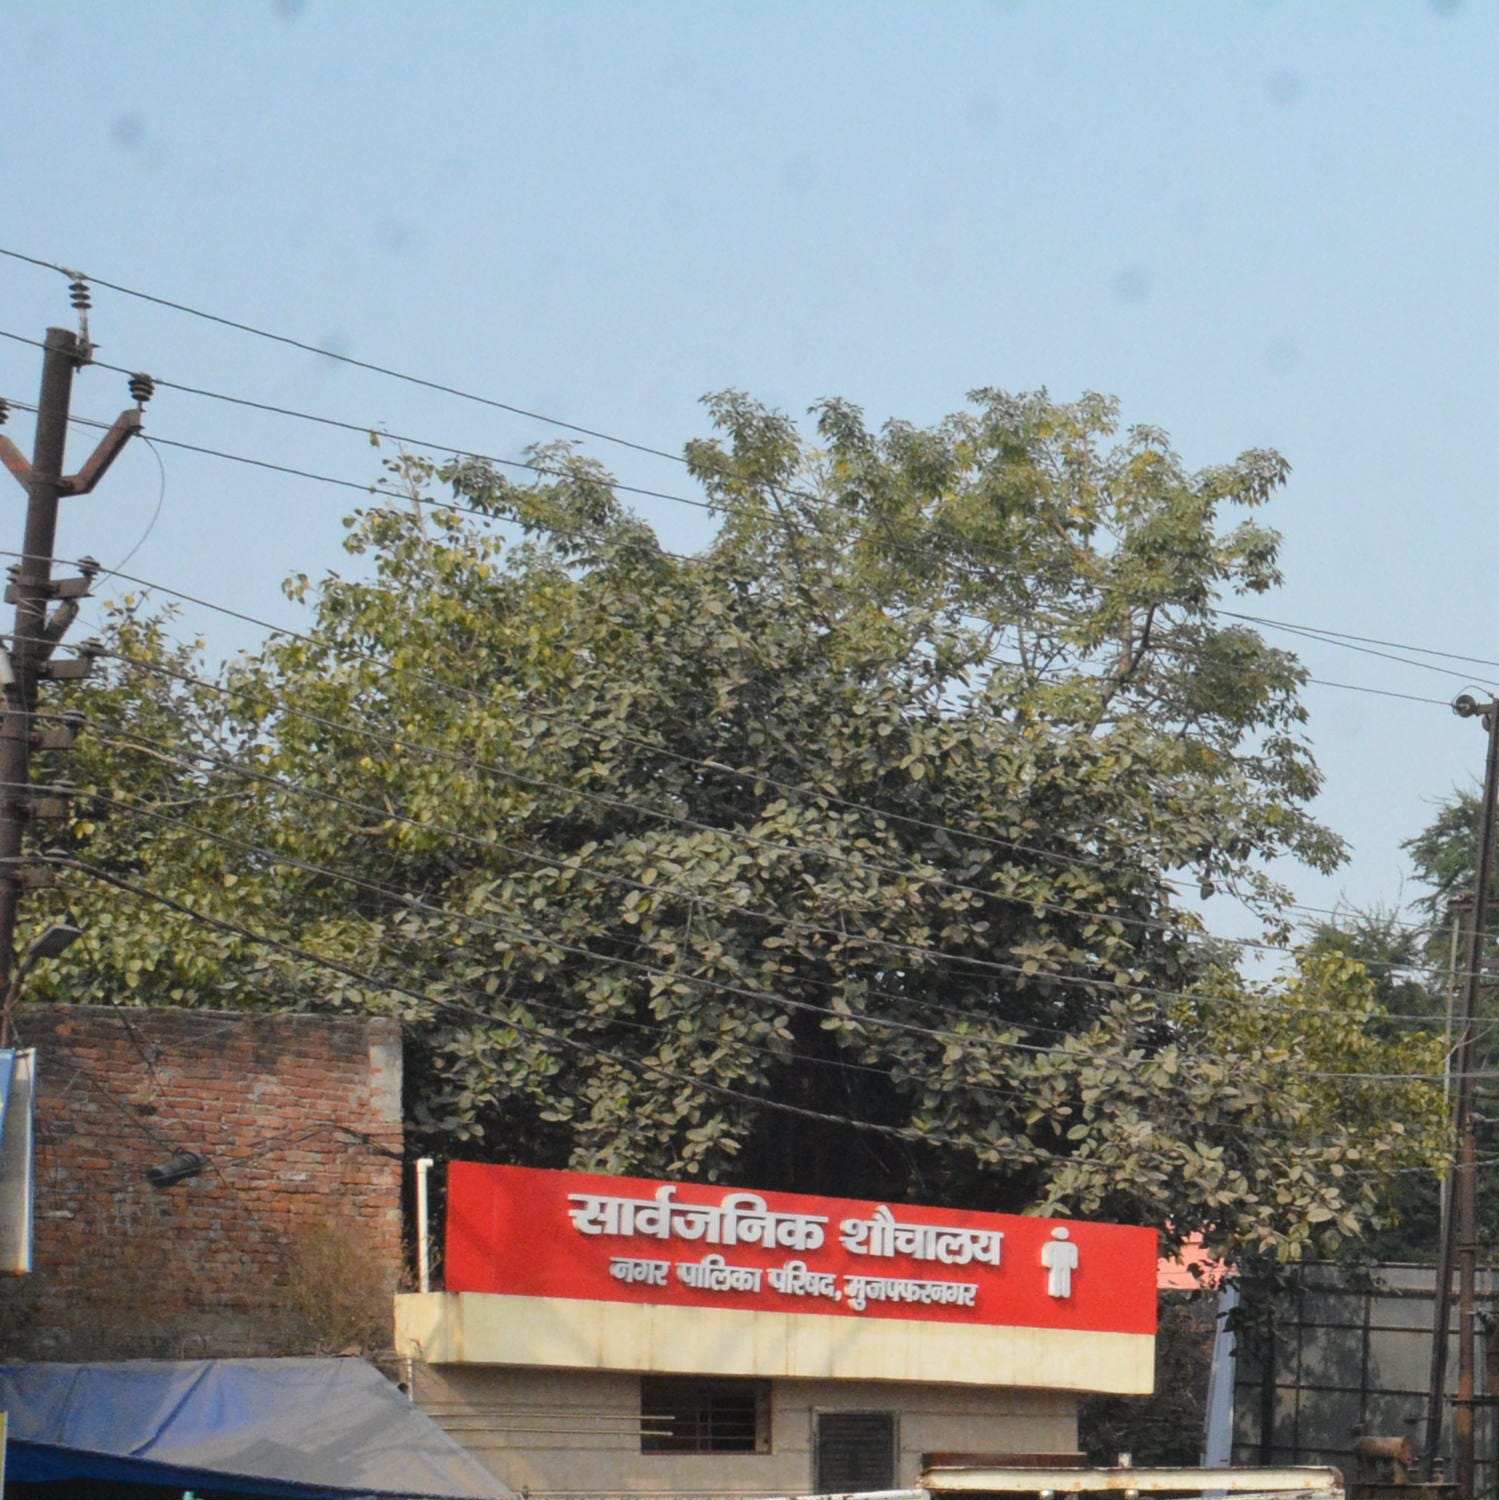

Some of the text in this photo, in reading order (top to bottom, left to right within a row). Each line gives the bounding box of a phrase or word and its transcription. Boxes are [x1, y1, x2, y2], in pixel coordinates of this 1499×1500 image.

[567, 1184, 1004, 1267] सार्वजनिक शौचालय
[610, 1255, 671, 1287] नगर
[676, 1251, 762, 1294] पालिका
